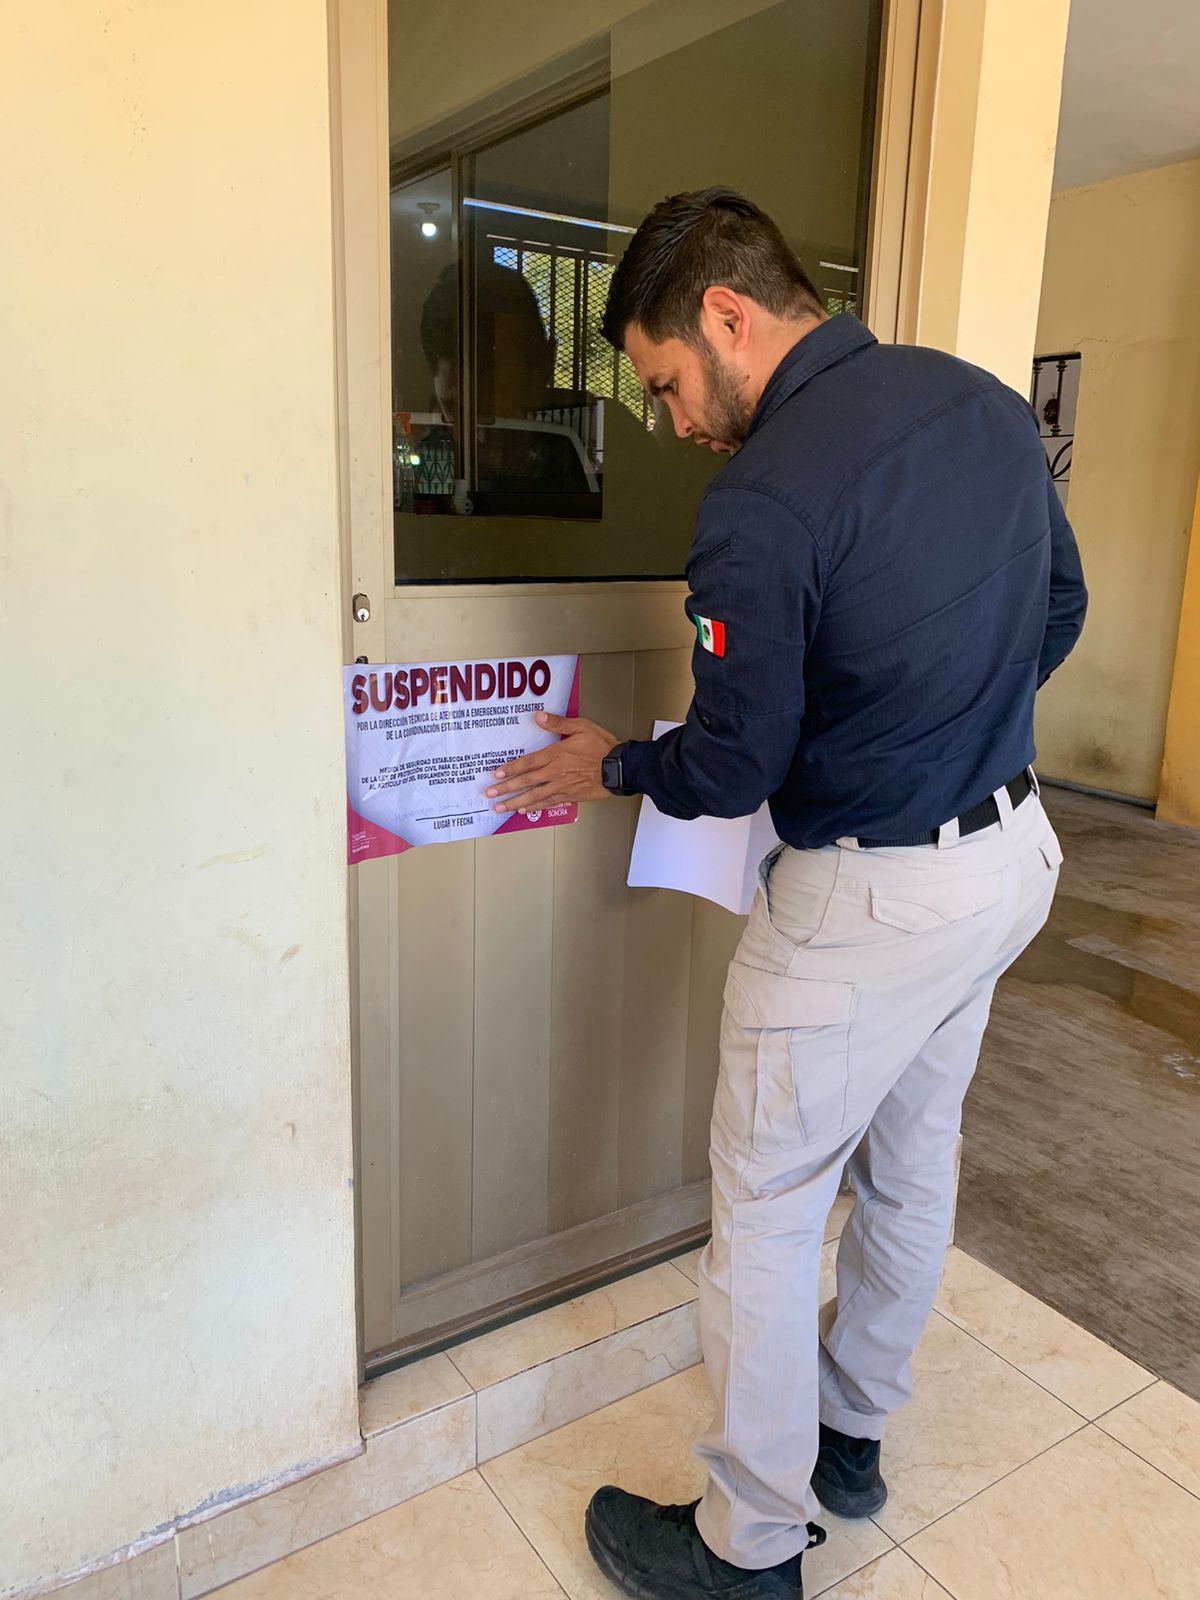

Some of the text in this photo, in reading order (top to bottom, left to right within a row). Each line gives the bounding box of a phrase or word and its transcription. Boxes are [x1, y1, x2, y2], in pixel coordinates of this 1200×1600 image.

[352, 659, 551, 714] SUSPENDIDO
[357, 721, 368, 732] POR
[370, 720, 377, 730] LA
[379, 716, 408, 729] DIRECCIÓN
[408, 712, 429, 725] TÉCNICA
[466, 709, 470, 717] A
[471, 705, 509, 717] EMERGENCIAS
[510, 705, 514, 713] Y
[515, 702, 544, 713] DESASTRES
[386, 716, 519, 740] DE LA COORDINACIÓN ESTATAL DE PROTECCIÓN CIVIL
[406, 759, 431, 770] SEGURIDAD
[432, 756, 463, 765] ESTABLECIDA
[481, 751, 507, 760] ARTÍCULOS
[397, 768, 423, 779] PROTECCIÓN
[459, 761, 476, 769] ESTADO
[417, 770, 450, 780] REGLAMENTO
[429, 778, 448, 786] ESTADO
[456, 775, 475, 784] SONORA
[547, 808, 568, 818] SONORA
[433, 819, 451, 830] LUGAR
[452, 819, 456, 827] Y
[456, 816, 473, 827] FECHA
